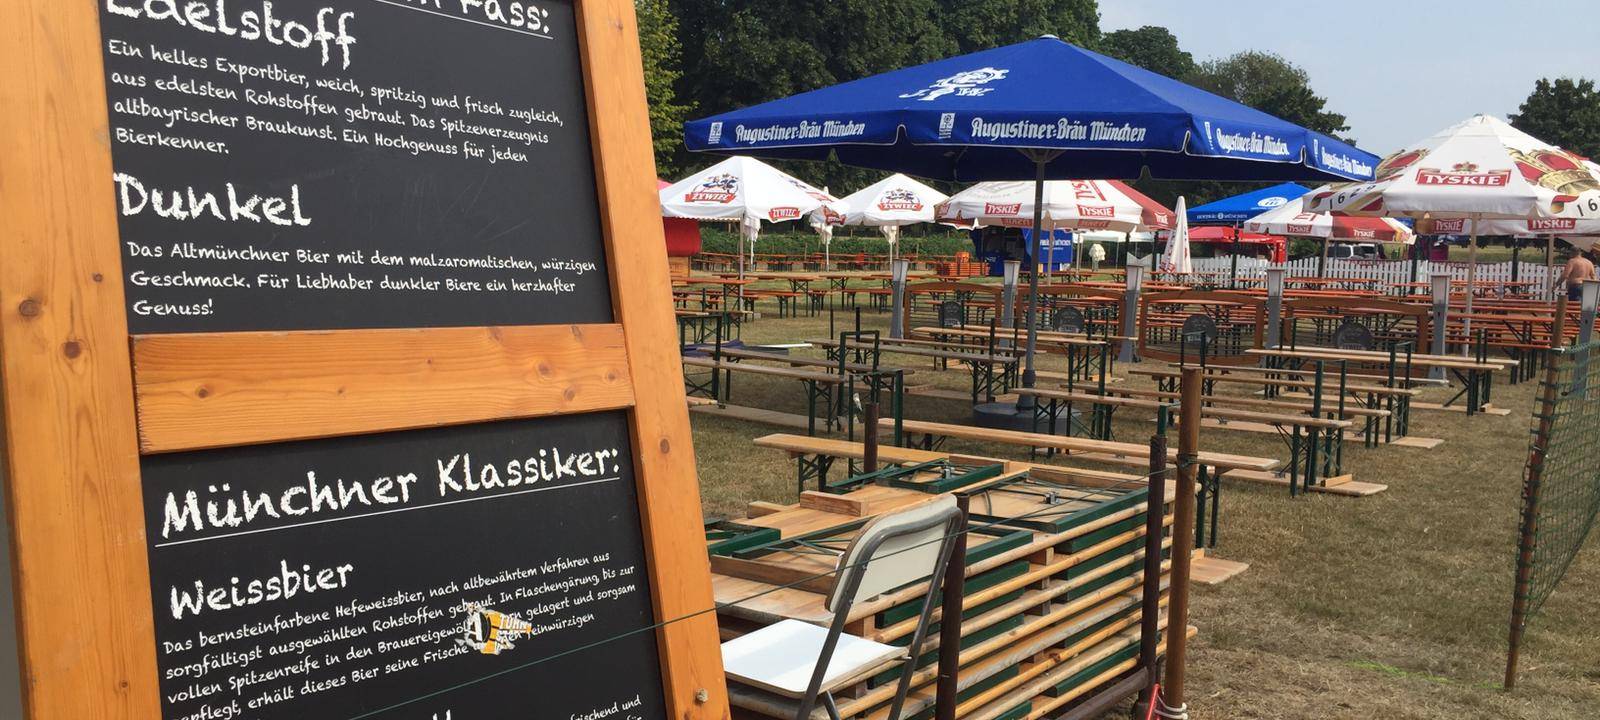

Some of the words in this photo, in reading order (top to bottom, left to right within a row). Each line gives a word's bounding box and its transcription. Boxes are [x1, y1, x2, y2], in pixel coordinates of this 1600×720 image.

[109, 39, 143, 58] Ein
[151, 44, 208, 68] helles
[216, 57, 310, 88] Exportbier,
[316, 78, 364, 97] weich,
[371, 85, 426, 109] spritzig
[432, 95, 460, 110] und
[465, 96, 504, 116] frisch
[509, 108, 563, 127] zugleich,
[112, 72, 147, 87] aus
[155, 75, 237, 101] edelsten
[245, 88, 338, 116] Rohstoffen
[345, 104, 406, 126] gebraut.
[411, 114, 435, 129] Das
[441, 118, 549, 146] Spitzenerzeugnis
[114, 98, 239, 128] altbayrischer
[245, 115, 338, 141] Braukunst.
[343, 129, 370, 144] Ein
[375, 133, 458, 155] Hochgenuss
[464, 141, 485, 160] für
[489, 147, 528, 164] jeden
[115, 127, 230, 154] Bierkenner.
[823, 120, 866, 138] München
[1090, 120, 1147, 142] München
[1424, 174, 1500, 186] TYSKIE
[113, 172, 312, 226] Dunkel
[987, 204, 1018, 214] TYSKIE
[1081, 206, 1112, 216] TYSKIE
[1288, 225, 1311, 233] TYSKIE
[1353, 229, 1376, 238] TYSKIE
[1436, 220, 1462, 231] TYSKIE
[127, 241, 163, 258] Das
[170, 242, 290, 263] Altmünchner
[296, 249, 330, 264] Bier
[337, 250, 365, 265] mit
[370, 251, 404, 266] dem
[410, 253, 538, 273] malzaromatischen,
[541, 259, 597, 275] würzigen
[130, 270, 251, 289] Geschmack.
[257, 274, 290, 289] Für
[296, 272, 373, 290] Liebhaber
[380, 276, 441, 292] dunkler
[446, 278, 482, 292] Biere
[486, 280, 507, 292] ein
[512, 277, 576, 295] herzhafter
[133, 298, 215, 316] Genuss!
[161, 467, 417, 539] Münchner
[437, 447, 621, 497] Klassiker:
[163, 639, 193, 654] Das
[199, 610, 331, 648] bernsteinfarbene
[335, 589, 425, 618] Hefeweissbier,
[429, 581, 459, 597] nach
[463, 568, 537, 590] altbewährtem
[540, 557, 590, 575] Verfahren
[593, 552, 610, 563] aus
[170, 559, 354, 620] Weissbier
[166, 645, 263, 680] sorgfältigst
[269, 626, 368, 655] ausgewählten
[372, 608, 444, 632] Rohstoffen
[499, 592, 514, 604] In
[602, 566, 616, 580] bis
[619, 565, 635, 576] zur
[168, 683, 223, 703] vollen
[228, 655, 320, 696] Spitzenreife
[325, 653, 340, 666] in
[346, 645, 373, 662] den
[526, 598, 570, 618] gelagert
[573, 591, 593, 605] und
[597, 583, 636, 601] sorgsam
[247, 686, 295, 710] erhält
[300, 675, 347, 696] dieses
[351, 667, 380, 683] Bier
[385, 656, 419, 675] seine
[423, 643, 469, 664] Frische
[622, 694, 642, 711] und
